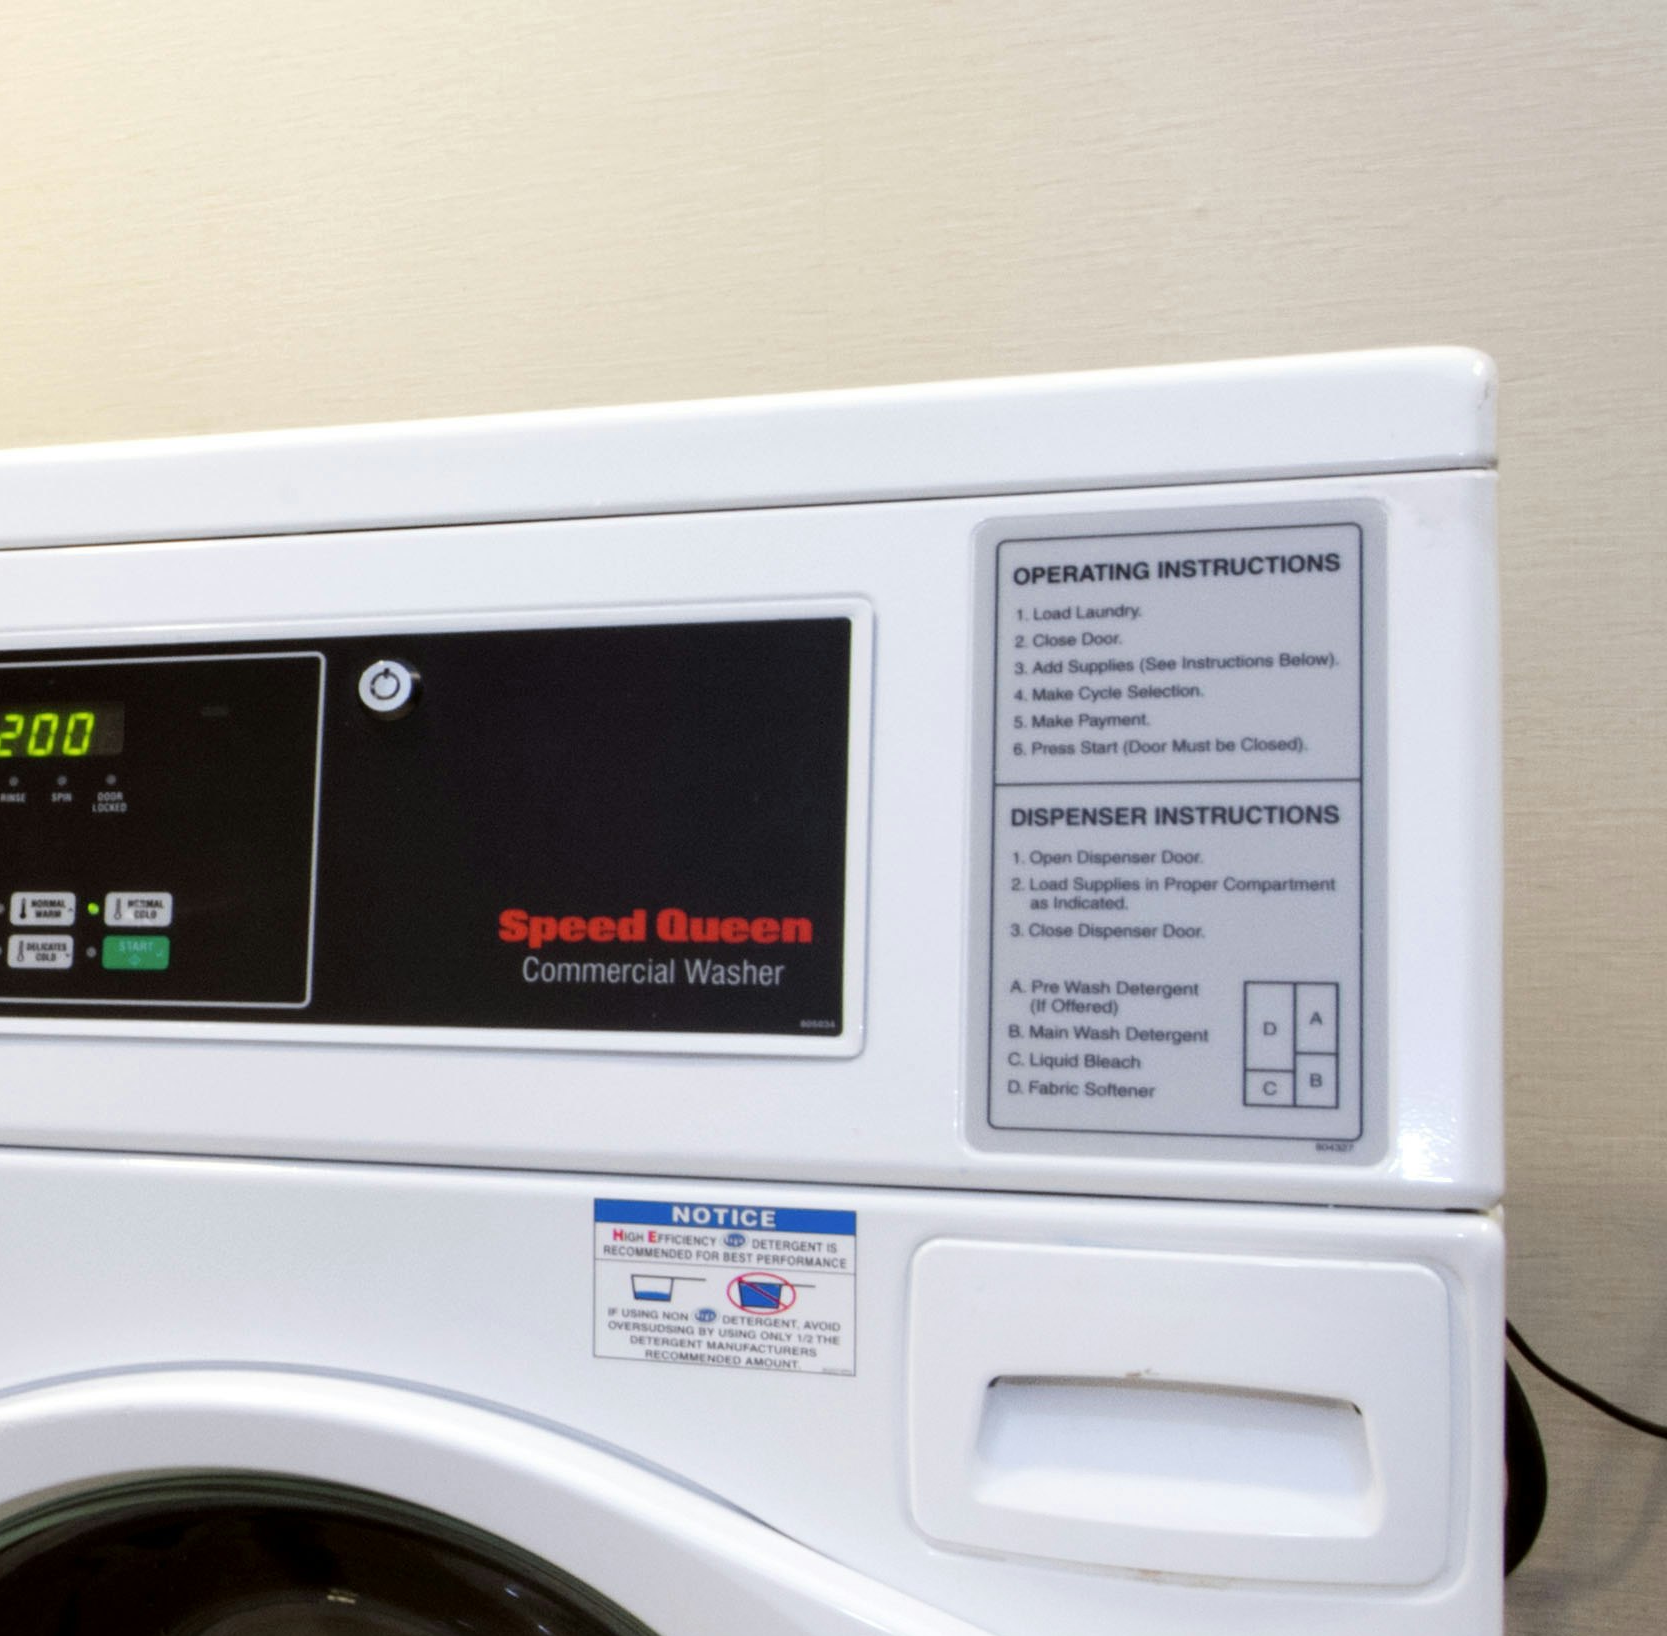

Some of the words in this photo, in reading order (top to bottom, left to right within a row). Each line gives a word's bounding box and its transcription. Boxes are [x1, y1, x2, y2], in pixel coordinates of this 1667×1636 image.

[1013, 562, 1150, 586] OPERATING
[1158, 554, 1341, 578] INSTRUCTIONS
[1017, 609, 1027, 621] 1.
[1033, 607, 1071, 620] Load
[1076, 605, 1141, 620] Laundry.
[1015, 636, 1027, 648] 2.
[1033, 633, 1076, 647] Close
[1082, 632, 1122, 646] Door.
[1015, 662, 1027, 675] 3.
[1033, 661, 1062, 674] Add
[1068, 658, 1134, 676] Supplies
[1140, 657, 1176, 672] (See
[1182, 655, 1273, 670] Instructions
[1279, 653, 1338, 668] Below).
[1015, 690, 1027, 701] 4.
[1032, 688, 1073, 700] Make
[1079, 686, 1122, 702] Cycle
[1127, 684, 1204, 699] Selection.
[1014, 716, 1026, 728] 5.
[1032, 715, 1073, 727] Make
[1078, 714, 1150, 729] Payment.
[1014, 743, 1026, 755] 6.
[1032, 742, 1075, 754] Press
[1081, 740, 1118, 754] Start
[1123, 740, 1167, 756] (Door
[1172, 740, 1210, 753] Must
[1216, 739, 1235, 753] be
[1241, 738, 1307, 753] Closed).
[1011, 808, 1146, 827] DISPENSER
[1155, 806, 1339, 825] INSTRUCTIONS
[1013, 853, 1025, 864] 1.
[1030, 851, 1071, 867] Open
[1077, 851, 1155, 867] Dispenser
[1162, 851, 1203, 864] Door.
[1011, 879, 1024, 891] 2.
[1030, 878, 1067, 891] Load
[1073, 877, 1140, 894] Supplies
[1146, 878, 1159, 890] in
[1165, 878, 1218, 894] Proper
[1224, 877, 1335, 894] Compartment
[1030, 900, 1048, 910] as
[1054, 897, 1127, 910] Indicated.
[499, 908, 647, 949] Speed
[656, 908, 813, 944] Queen
[1011, 924, 1024, 936] 3.
[1029, 924, 1072, 937] Close
[1078, 924, 1157, 941] Dispenser
[1163, 924, 1205, 938] Door.
[523, 956, 675, 983] Commercial
[685, 960, 785, 985] Washer
[1010, 981, 1025, 993] A.
[1031, 981, 1059, 993] Pre
[1065, 981, 1110, 995] Wash
[1116, 982, 1199, 998] Detergent
[1030, 999, 1048, 1015] (If
[1051, 999, 1118, 1016] Offered)
[1310, 1012, 1322, 1025] A
[1009, 1025, 1024, 1038] B.
[1030, 1027, 1068, 1039] Main
[1073, 1027, 1120, 1041] Wash
[1126, 1028, 1209, 1045] Detergent
[1264, 1022, 1276, 1036] D
[1008, 1053, 1024, 1066] C.
[1030, 1054, 1079, 1070] Liquid
[1084, 1054, 1140, 1069] Bleach
[1263, 1082, 1277, 1095] C
[1310, 1074, 1322, 1087] B
[1007, 1081, 1023, 1094] D.
[1029, 1081, 1079, 1096] Fabric
[1084, 1082, 1155, 1098] Softener
[672, 1206, 776, 1228] NOTICE
[603, 1245, 692, 1260] RECOMMENDED
[696, 1250, 719, 1262] FOR
[723, 1252, 752, 1264] BEST
[757, 1254, 846, 1269] PERFORMANCE
[608, 1308, 618, 1316] IF
[622, 1308, 658, 1320] USING
[663, 1312, 688, 1321] NON
[803, 1321, 840, 1332] AVOID
[608, 1320, 694, 1336] OVERSUDSING
[699, 1327, 713, 1336] BY
[719, 1328, 755, 1340] USING
[761, 1331, 791, 1342] ONLY
[797, 1333, 813, 1343] 1/2
[817, 1335, 839, 1345] THE
[630, 1335, 703, 1350] DETERGENT
[707, 1341, 817, 1358] MANUFACTURERS
[645, 1350, 741, 1366] RECOMMENDED
[745, 1358, 800, 1370] AMOUNT.
